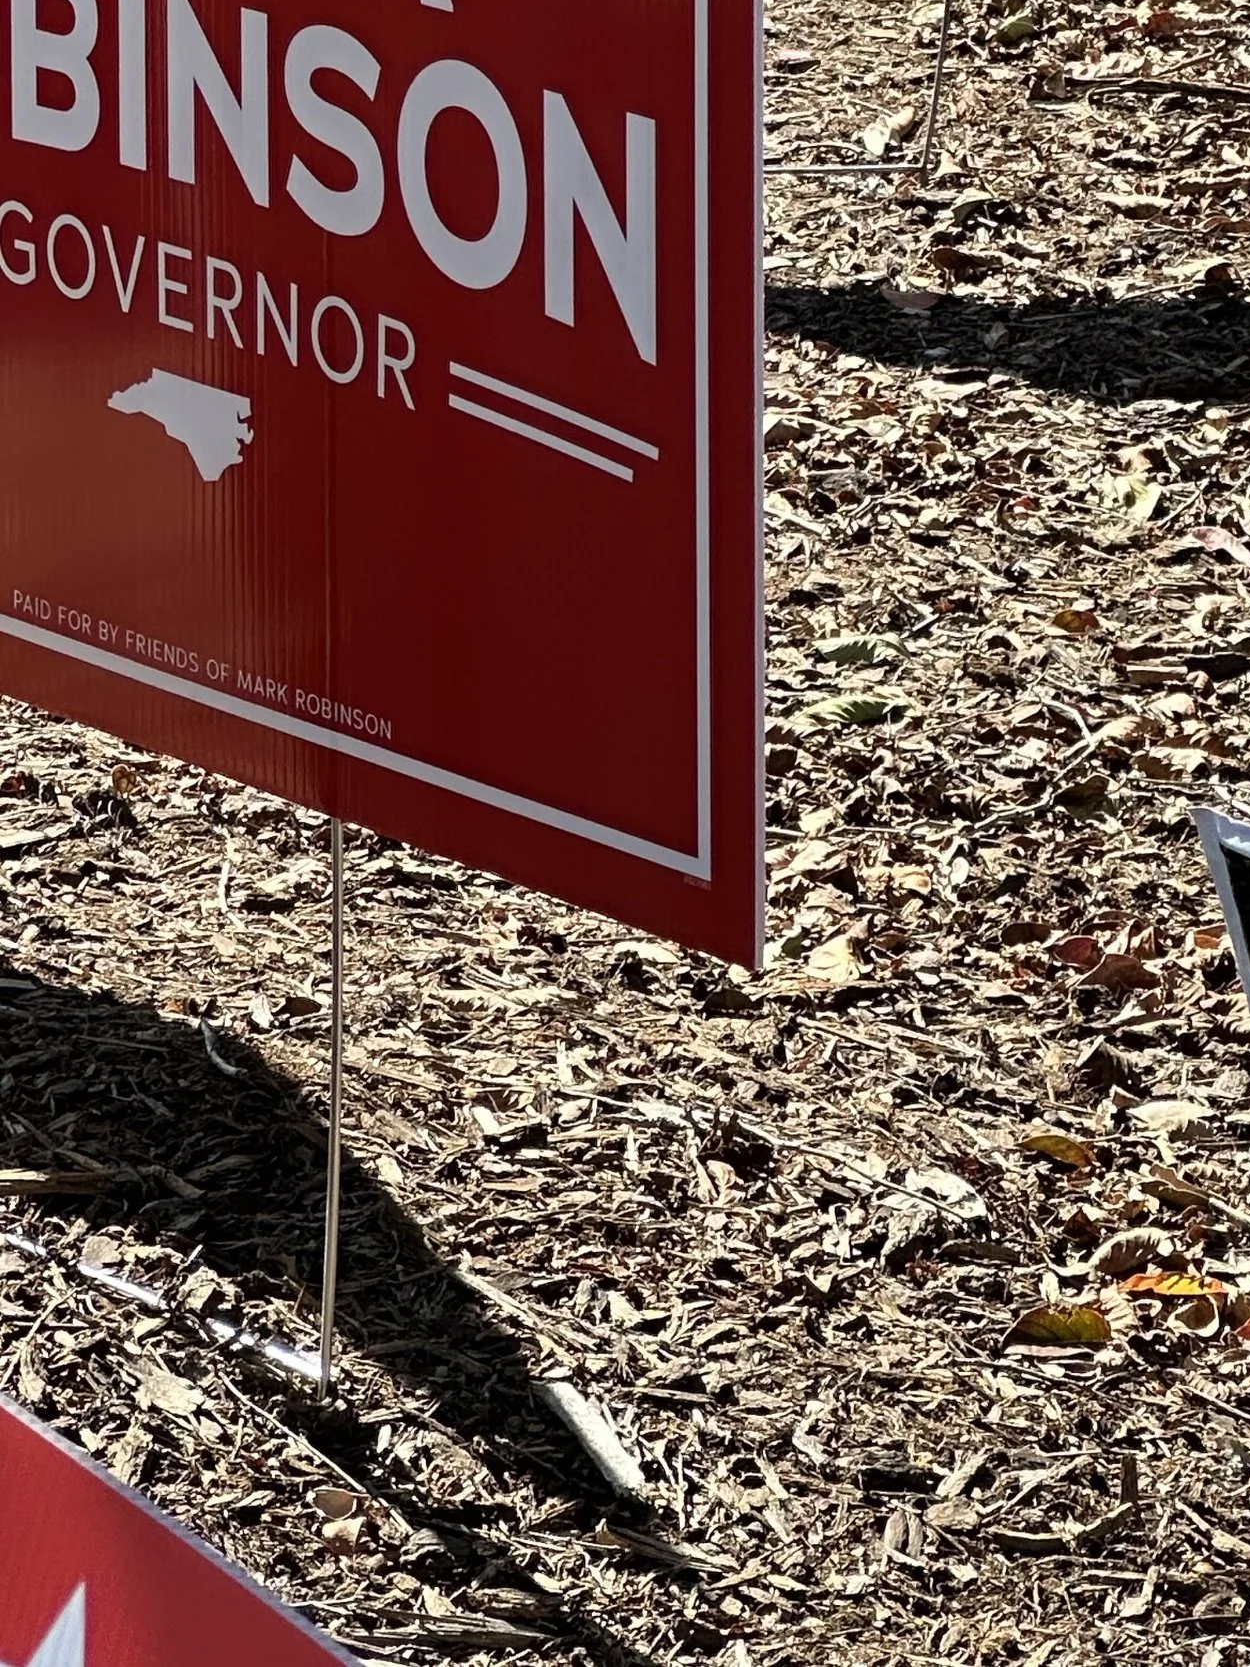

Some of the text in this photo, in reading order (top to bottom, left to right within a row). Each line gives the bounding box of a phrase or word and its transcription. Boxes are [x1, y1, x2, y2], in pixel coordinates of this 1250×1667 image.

[0, 200, 416, 411] GOVERNOR
[13, 589, 392, 740] PAID FOR BY FRIENDS OF MARK ROBINSON
